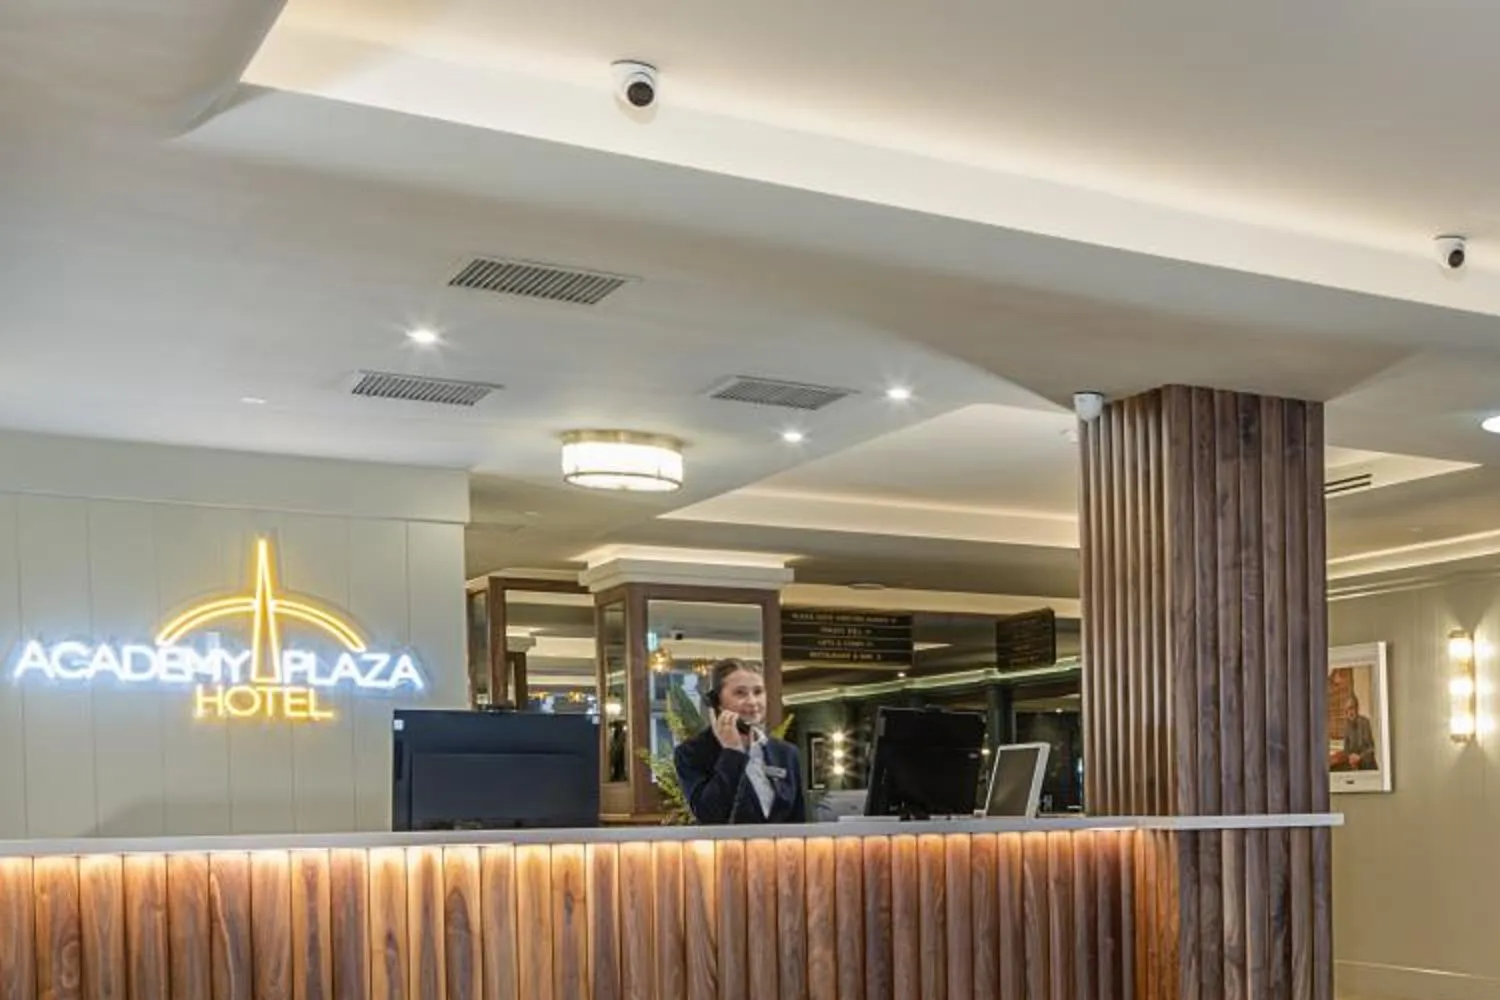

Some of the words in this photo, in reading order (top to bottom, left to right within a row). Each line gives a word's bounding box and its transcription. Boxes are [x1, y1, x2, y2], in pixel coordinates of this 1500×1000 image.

[13, 640, 250, 682] ACADEMY
[282, 649, 424, 690] PLAZA
[195, 685, 335, 718] HOTEL
